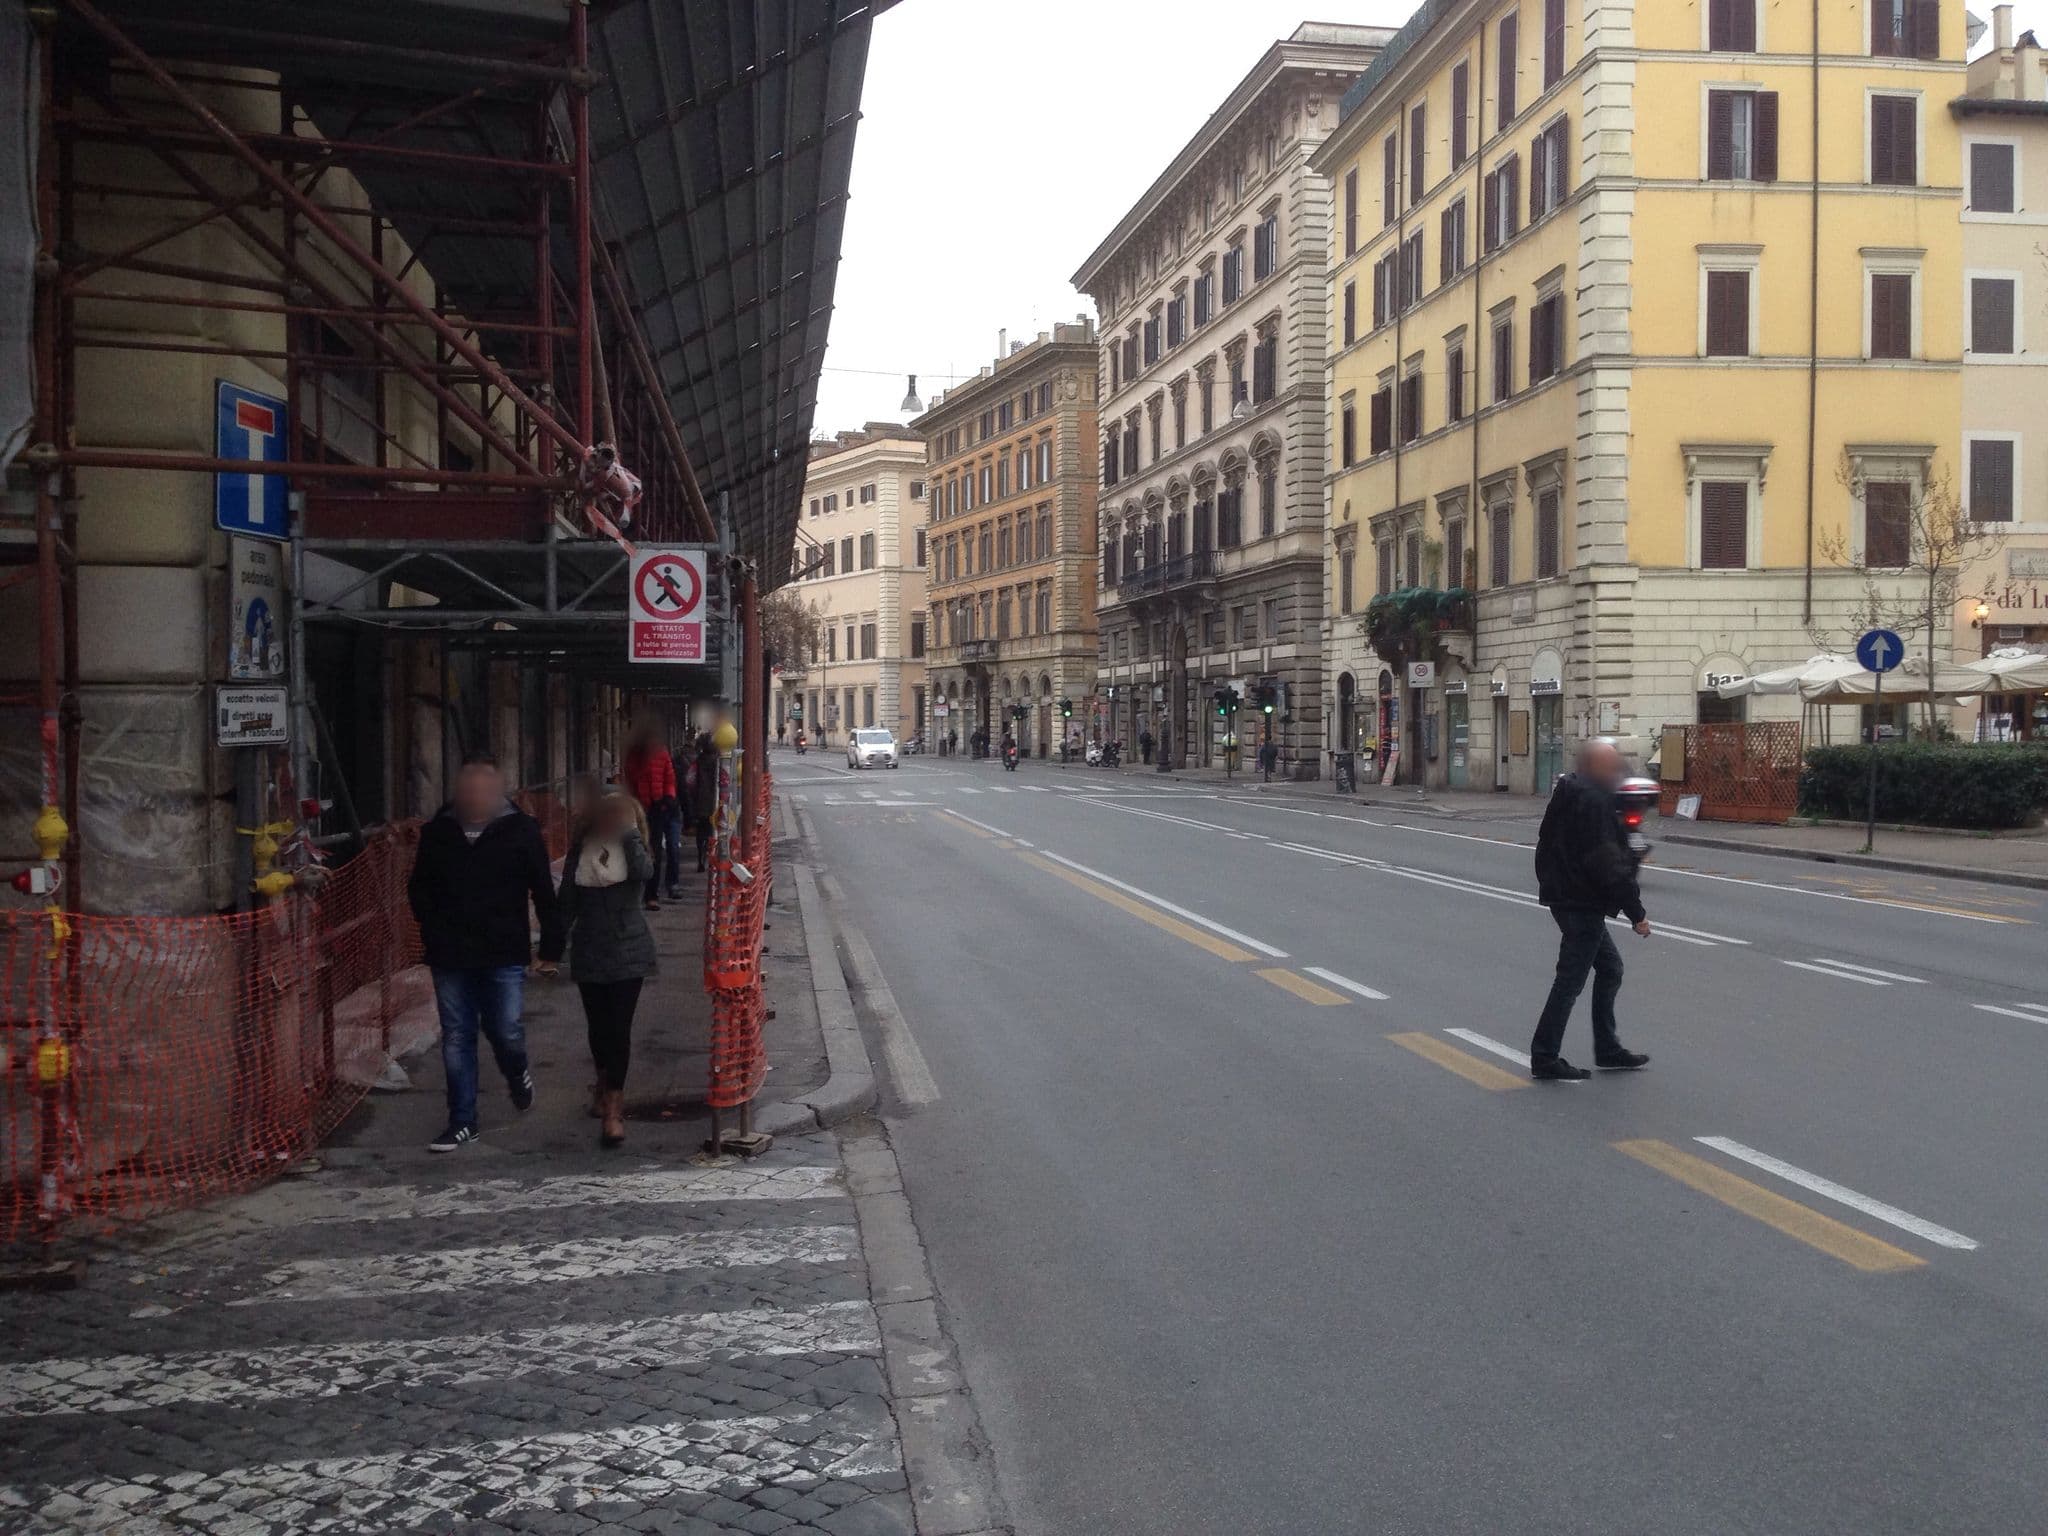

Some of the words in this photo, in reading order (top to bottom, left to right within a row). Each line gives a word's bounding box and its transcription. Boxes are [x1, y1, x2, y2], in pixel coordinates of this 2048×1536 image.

[226, 694, 254, 704] eccetto
[256, 693, 279, 703] veicoli
[232, 711, 255, 720] diretti
[248, 728, 285, 738] fabbricati
